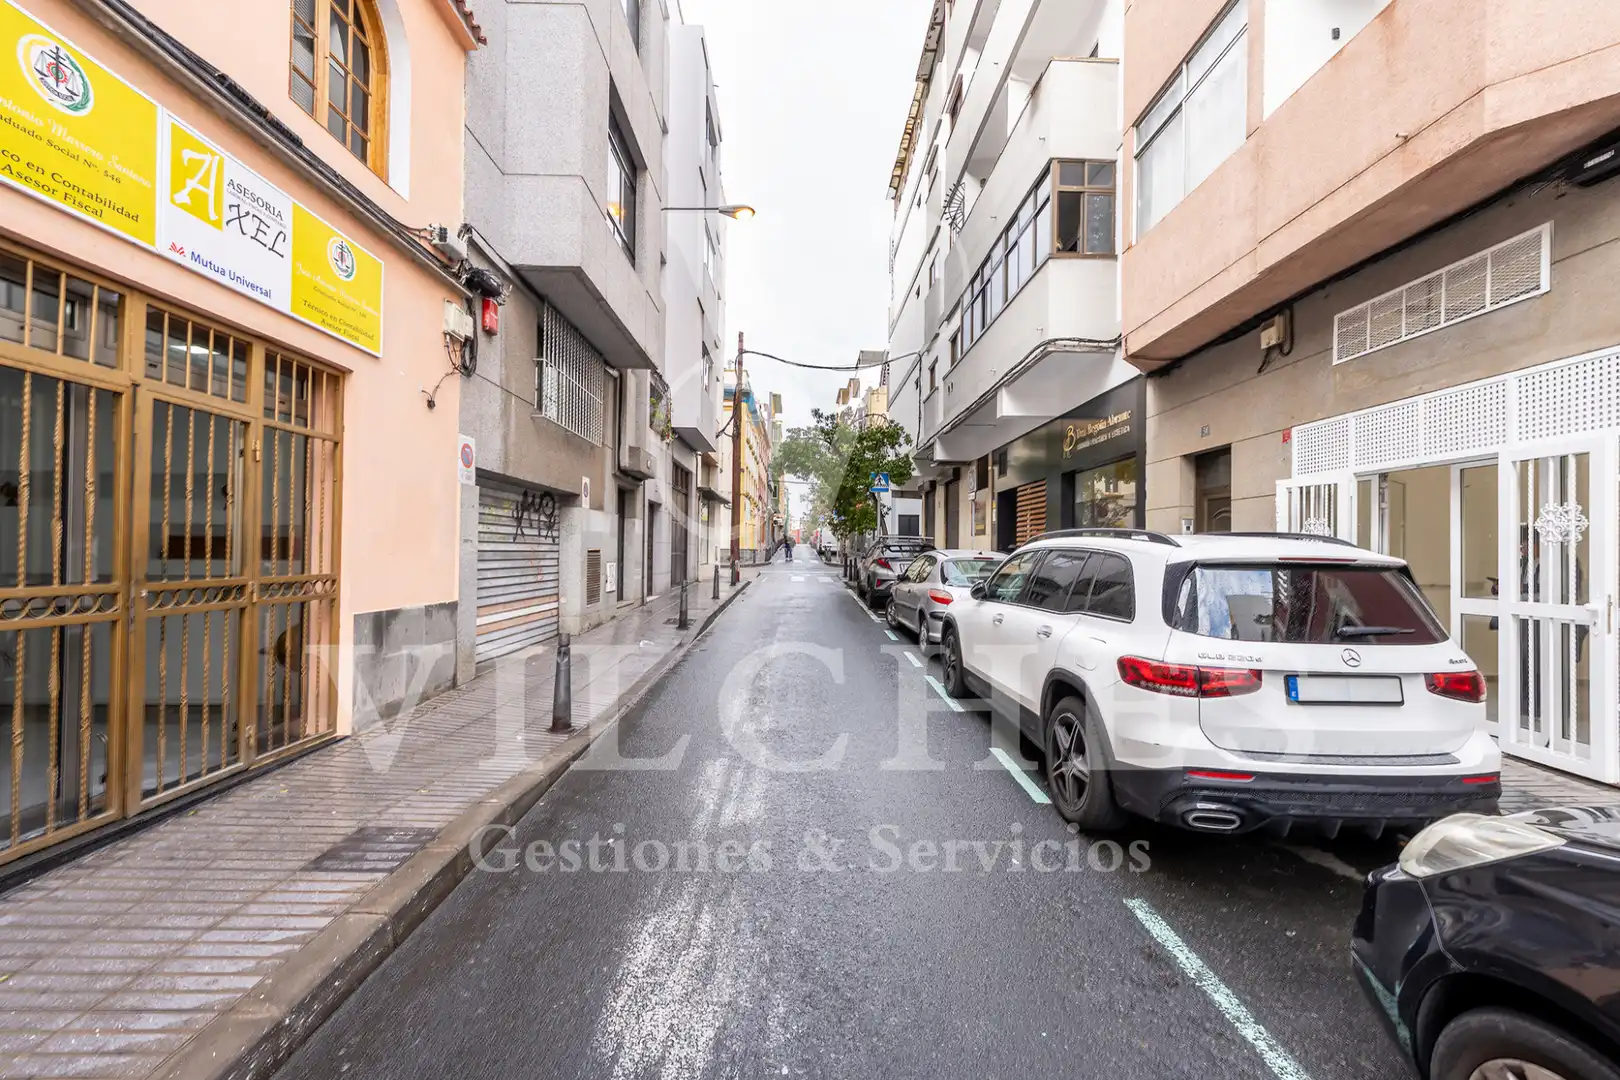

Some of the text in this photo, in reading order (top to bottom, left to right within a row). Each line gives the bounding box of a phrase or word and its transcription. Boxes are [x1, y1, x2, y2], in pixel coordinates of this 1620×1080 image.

[46, 138, 80, 162] Social
[103, 169, 121, 184] 546
[1, 163, 104, 218] Asesor Fiscal
[26, 162, 45, 176] en
[51, 172, 140, 223] Contabilidad
[227, 178, 284, 222] ASESORIA
[190, 251, 272, 299] Mutua Universal
[329, 314, 338, 324] en
